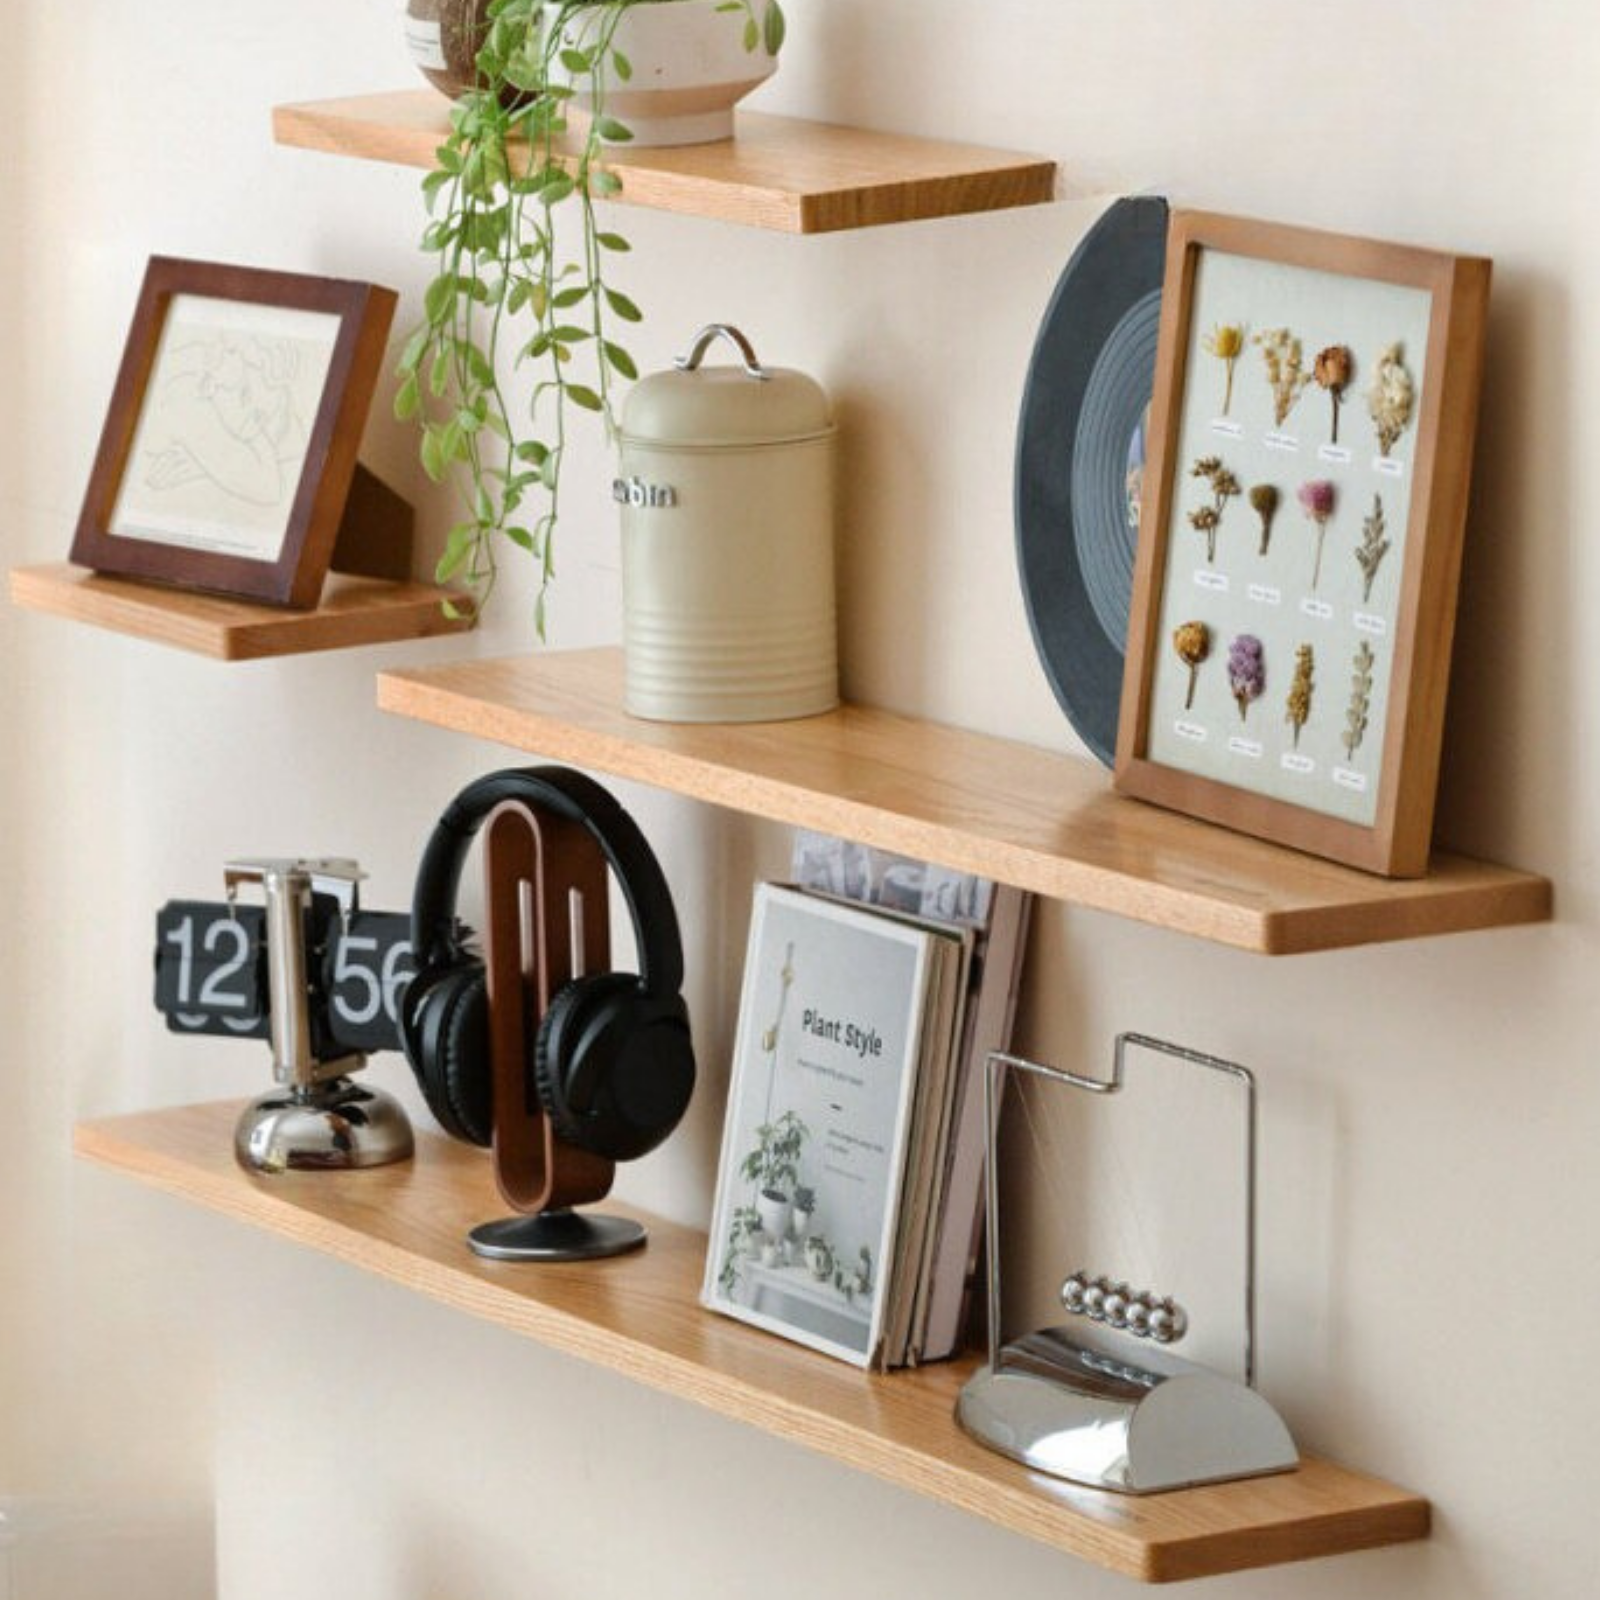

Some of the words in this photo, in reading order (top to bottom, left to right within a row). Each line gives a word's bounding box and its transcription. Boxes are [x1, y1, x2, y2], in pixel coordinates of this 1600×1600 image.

[166, 915, 249, 1007] 12
[802, 1007, 841, 1044] Plant
[844, 1022, 883, 1058] Style
